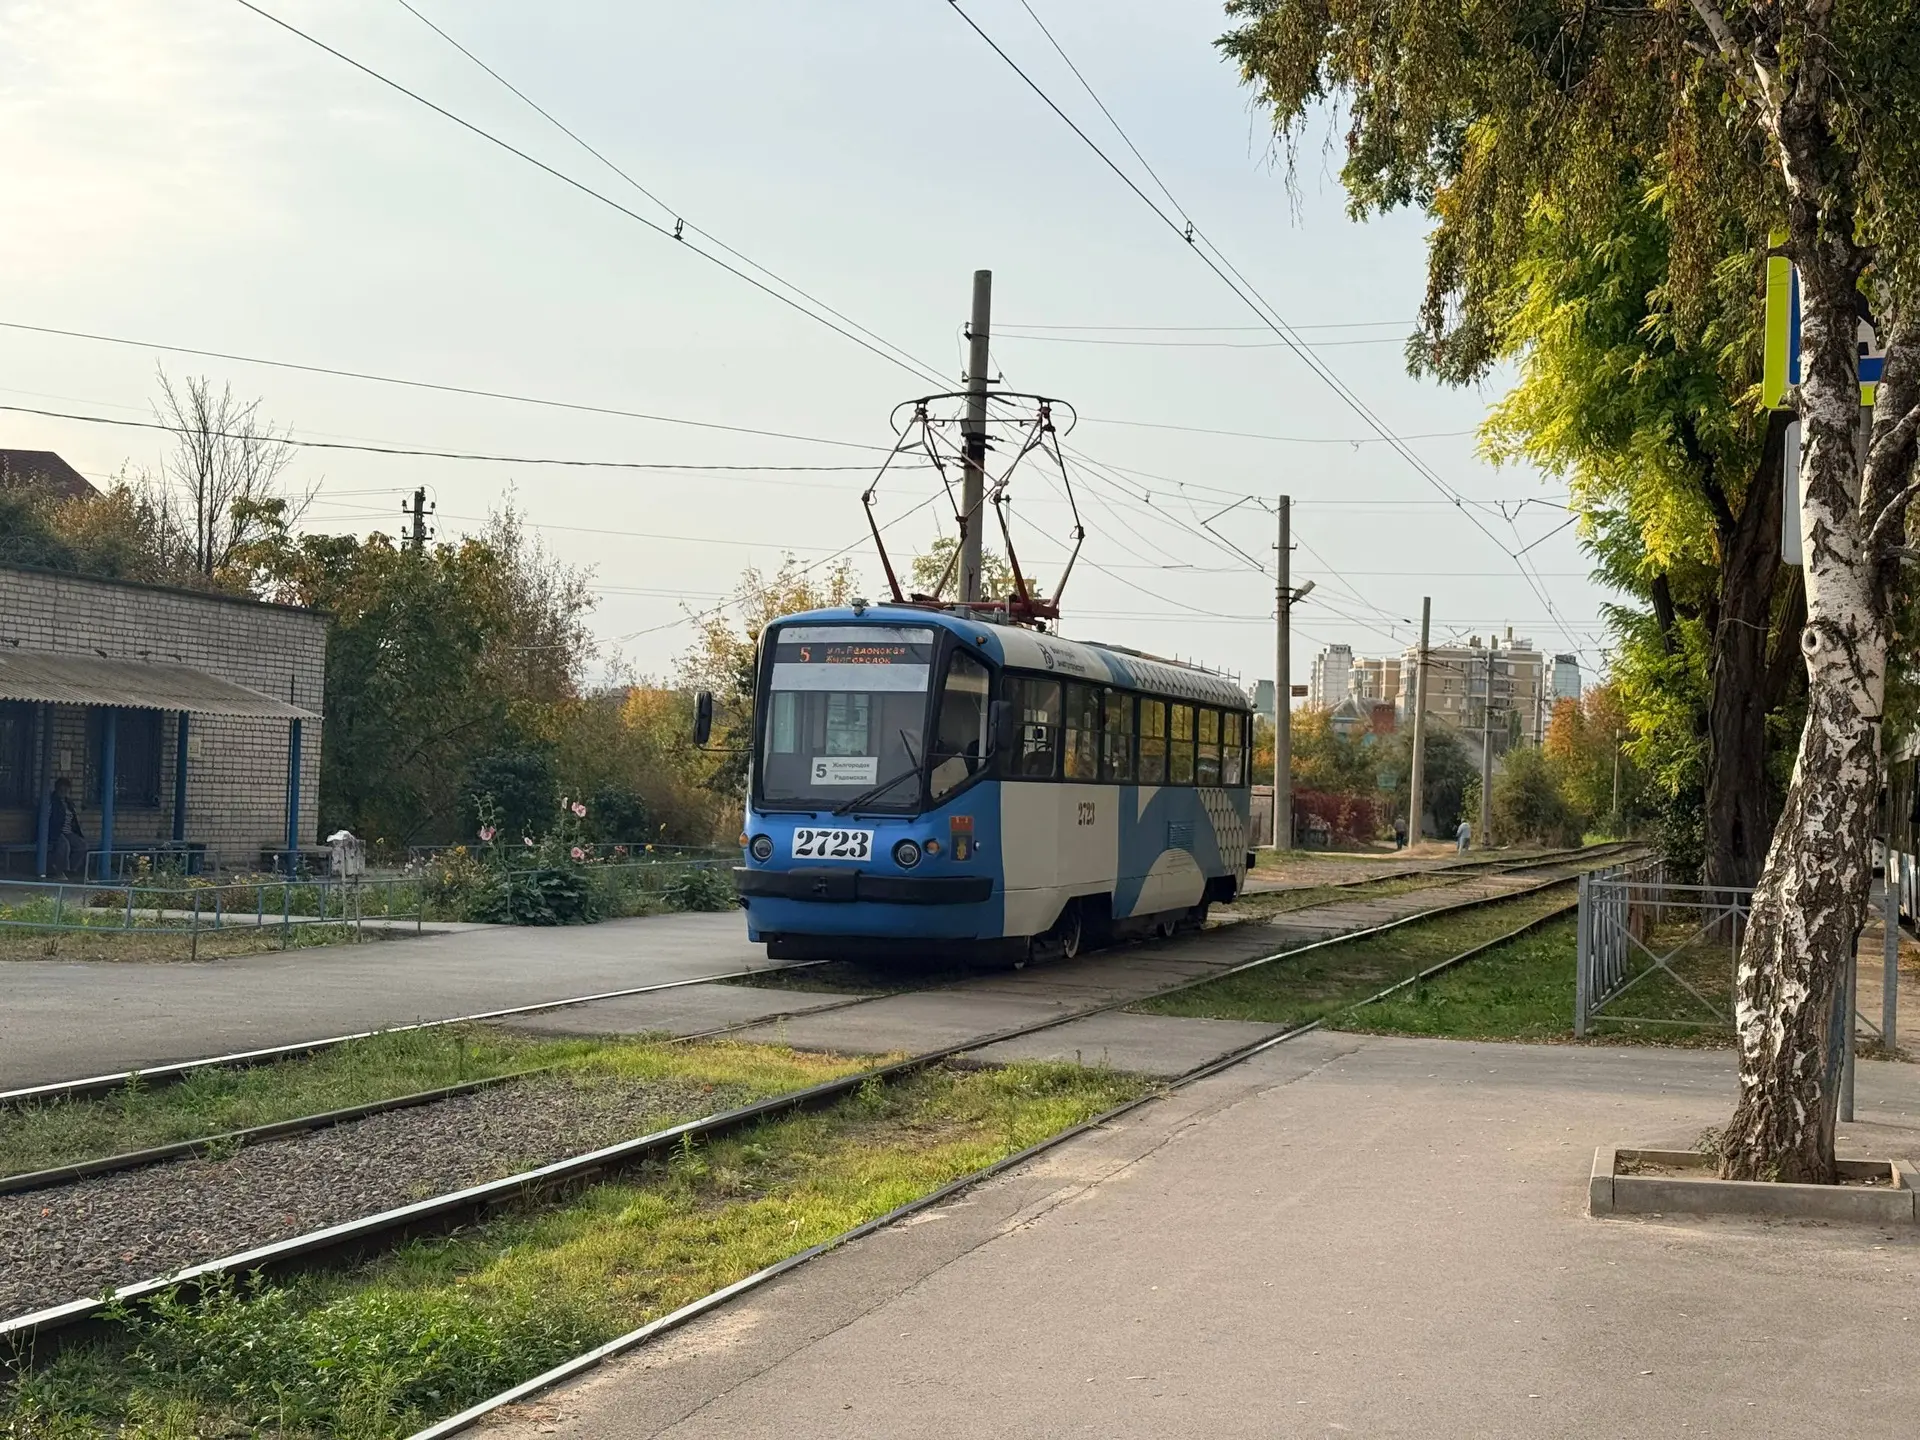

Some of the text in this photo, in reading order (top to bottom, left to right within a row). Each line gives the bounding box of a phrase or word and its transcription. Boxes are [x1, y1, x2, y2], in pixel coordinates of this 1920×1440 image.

[800, 647, 811, 662] 5
[816, 763, 827, 779] 5
[1078, 802, 1095, 826] 2723
[795, 830, 869, 858] 2723
